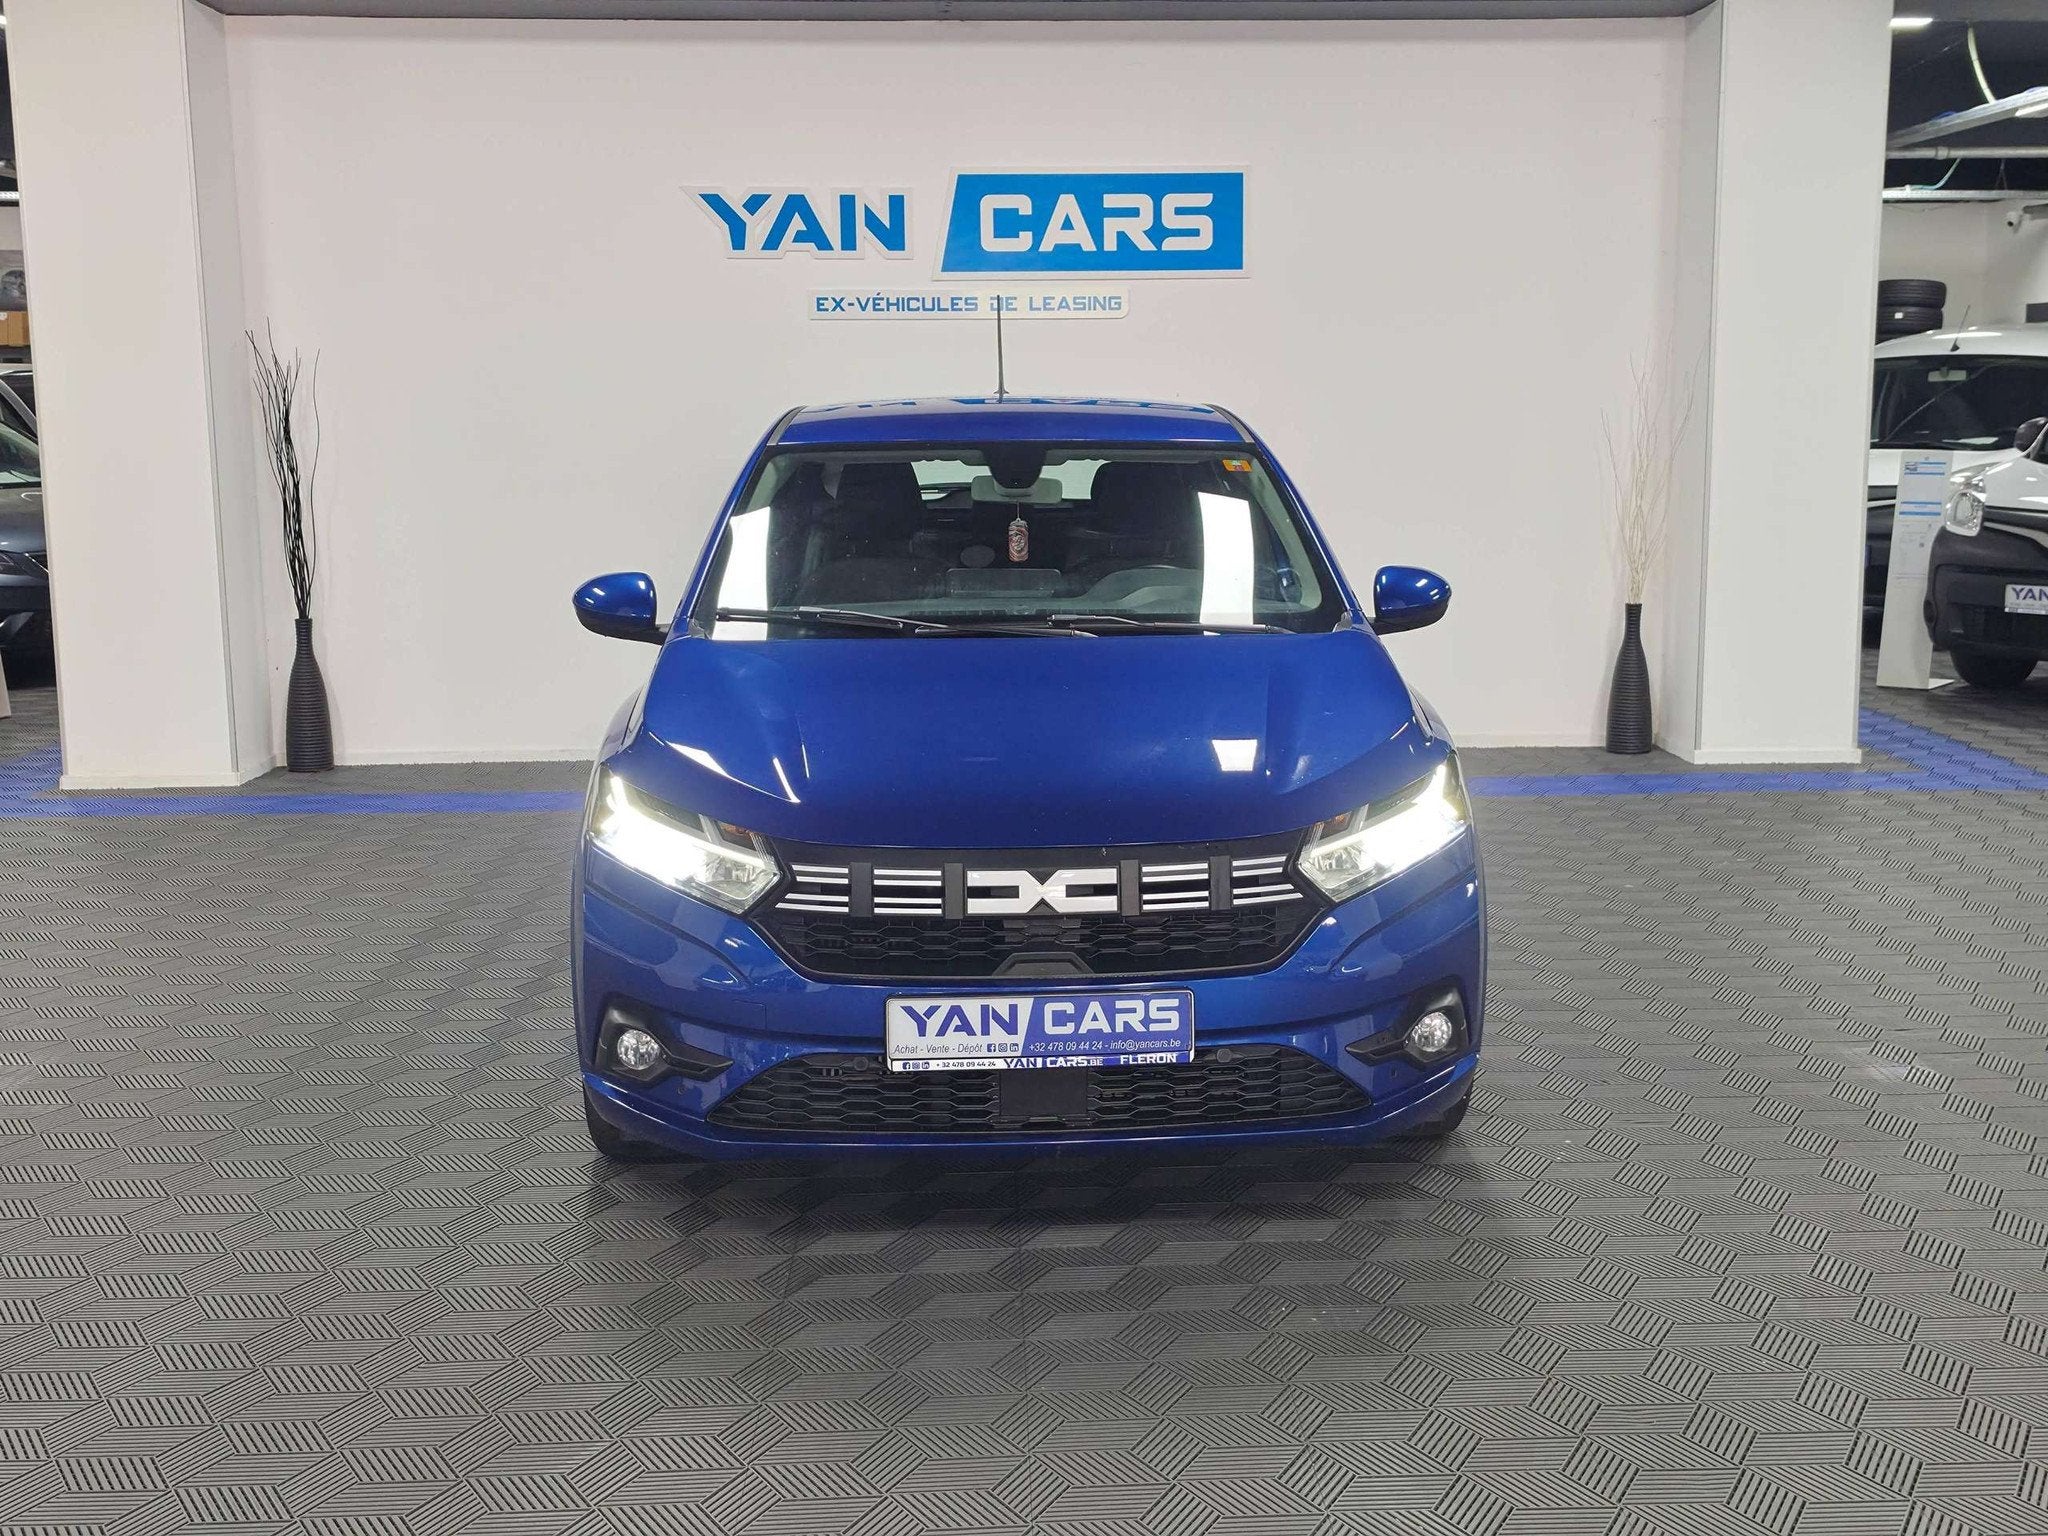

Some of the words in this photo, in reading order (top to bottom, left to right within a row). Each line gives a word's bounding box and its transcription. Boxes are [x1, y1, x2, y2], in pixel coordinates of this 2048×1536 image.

[698, 193, 906, 251] YAN
[980, 193, 1214, 252] CARS
[815, 292, 978, 312] EX-VÉHICULES
[989, 296, 1018, 311] DE
[1029, 296, 1122, 312] LEASING
[900, 1004, 1018, 1036] YAN
[1044, 999, 1179, 1034] CARS
[894, 1044, 918, 1054] Achat
[926, 1044, 950, 1054] Vente
[957, 1042, 982, 1054] Dépôt
[1029, 1042, 1045, 1052] +32
[1048, 1041, 1064, 1051] 478
[1066, 1041, 1076, 1051] 09
[1078, 1041, 1089, 1050] 44
[1092, 1040, 1102, 1050] 24
[1110, 1038, 1181, 1050] info@yancars.be
[1004, 1058, 1037, 1068] YAN
[1120, 1052, 1177, 1065] FLERON
